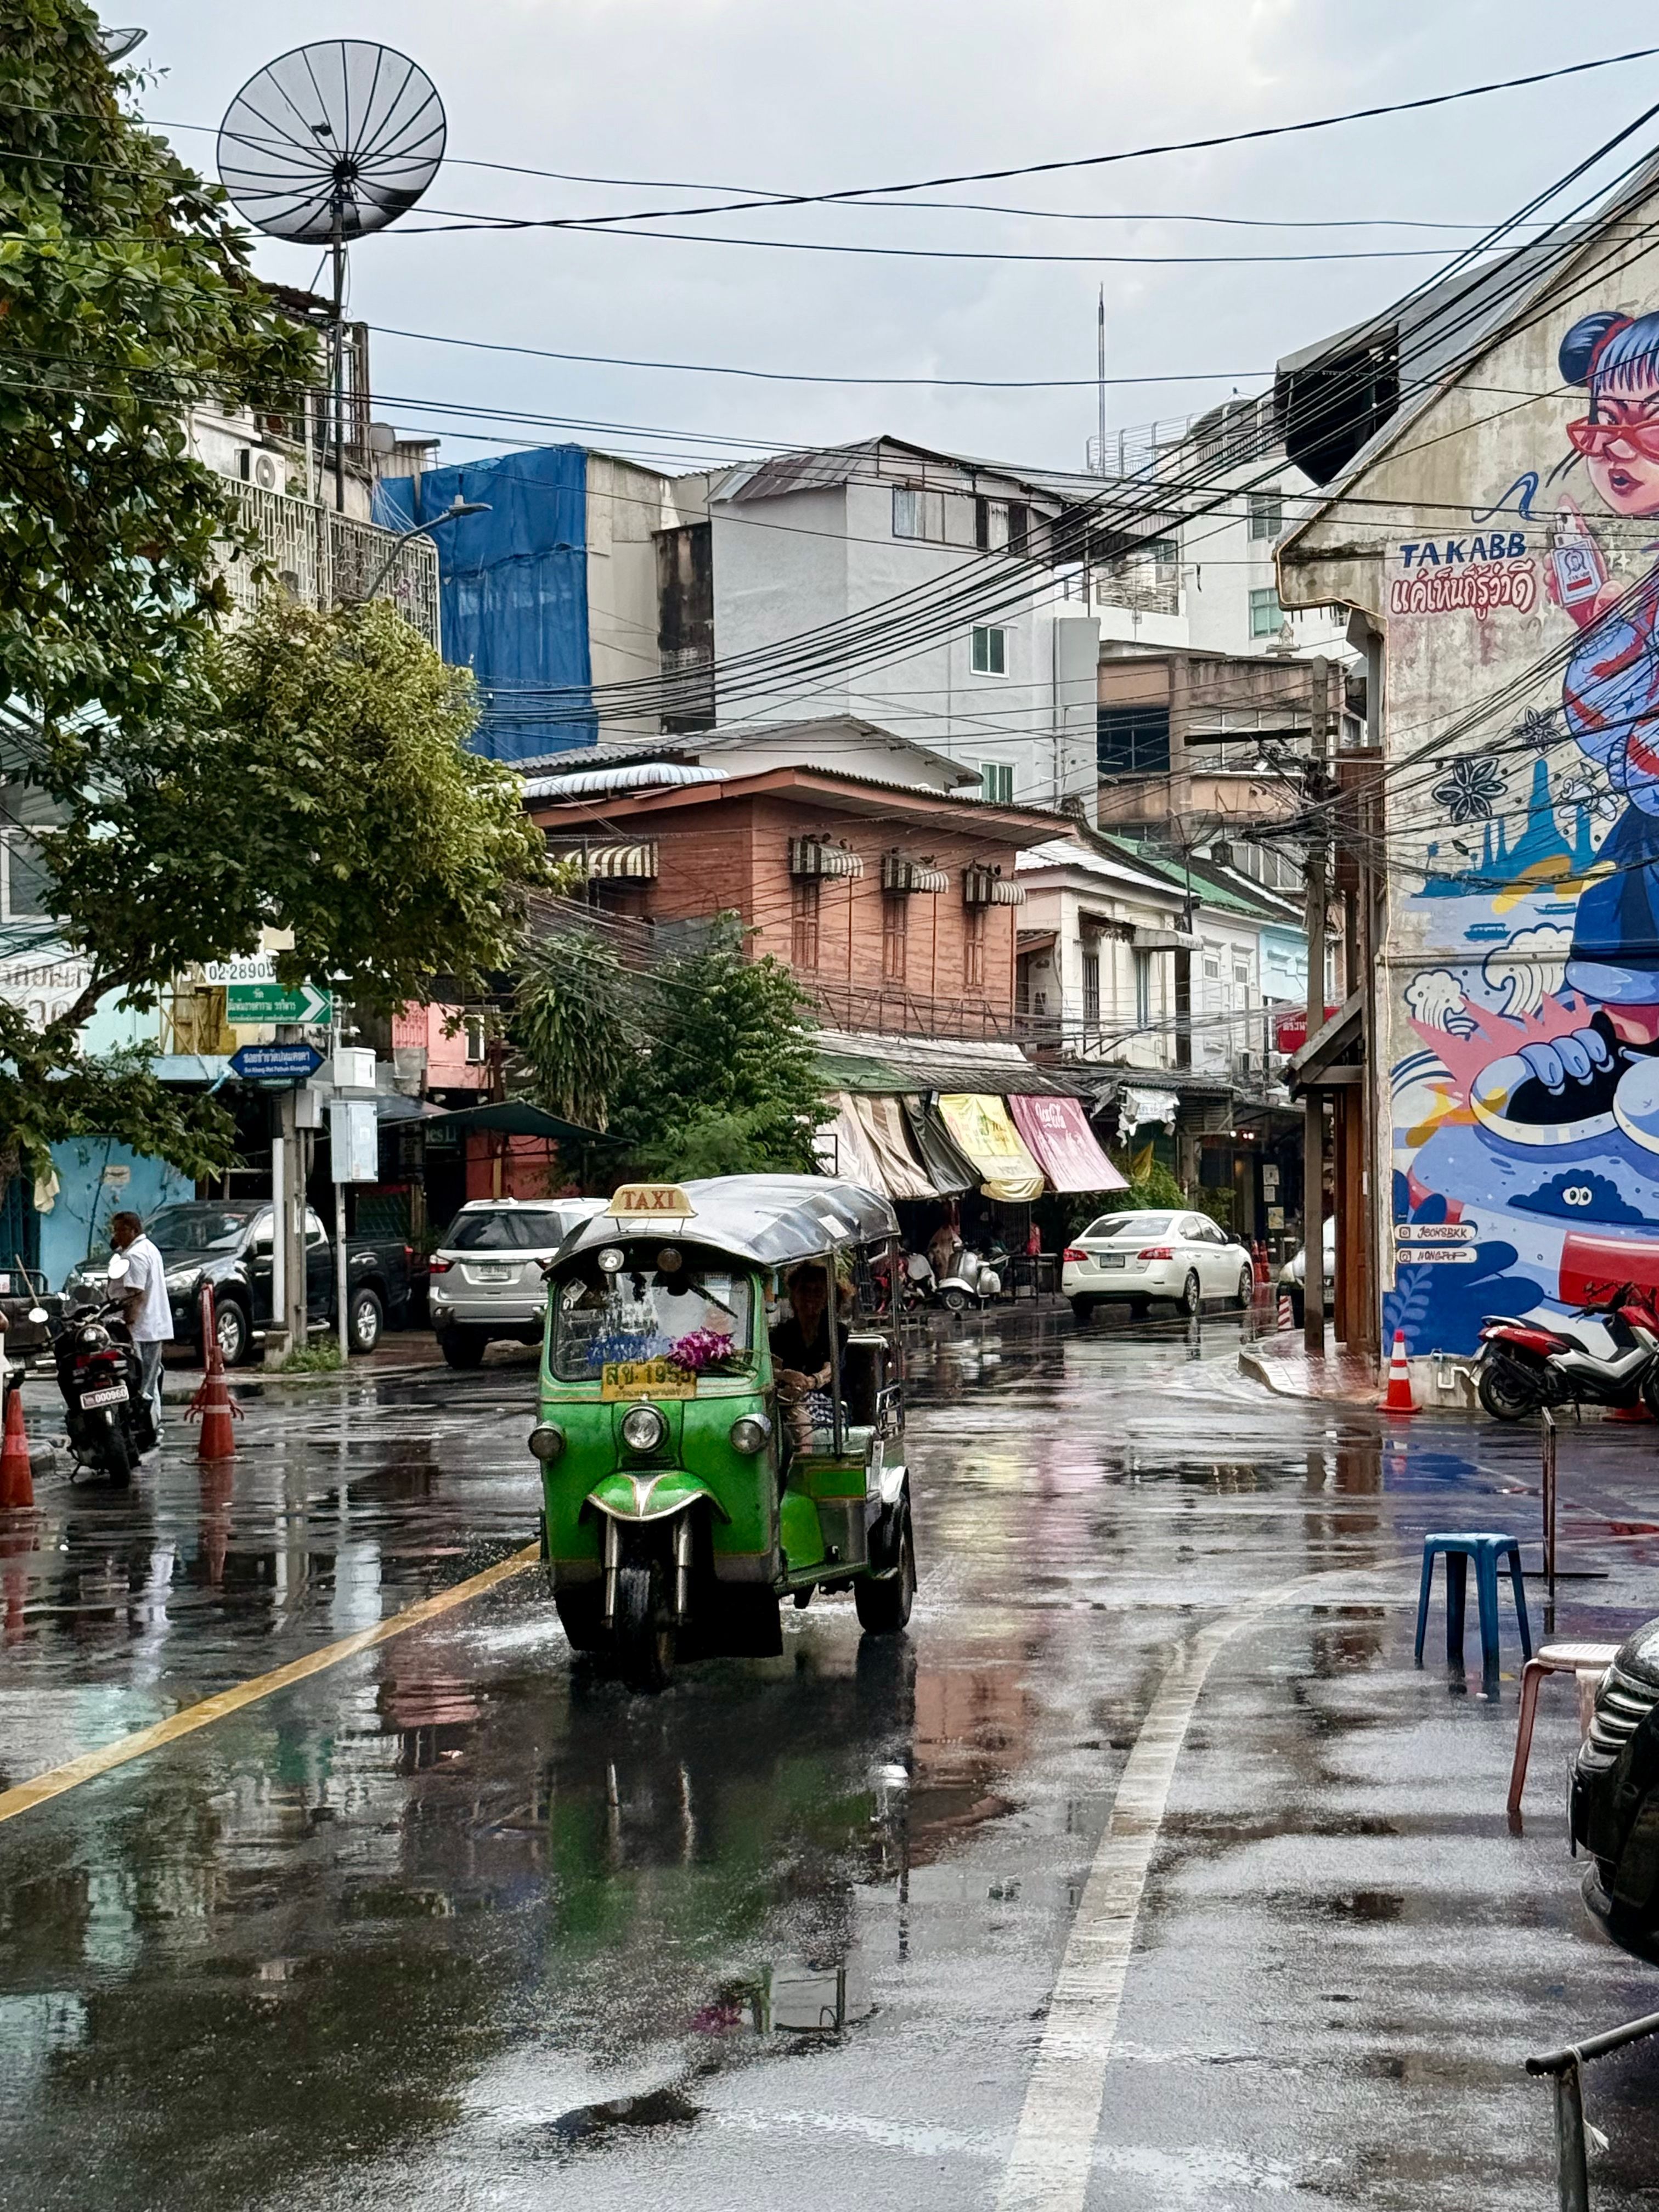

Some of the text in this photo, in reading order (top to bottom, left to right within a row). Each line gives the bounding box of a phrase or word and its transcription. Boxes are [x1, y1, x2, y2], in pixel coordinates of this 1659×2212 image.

[1400, 532, 1526, 568] TAKABB
[1391, 558, 1536, 620] แค่เห็นก็รู้ว่าดี
[622, 1189, 676, 1210] TAXI
[94, 1389, 127, 1403] 000960
